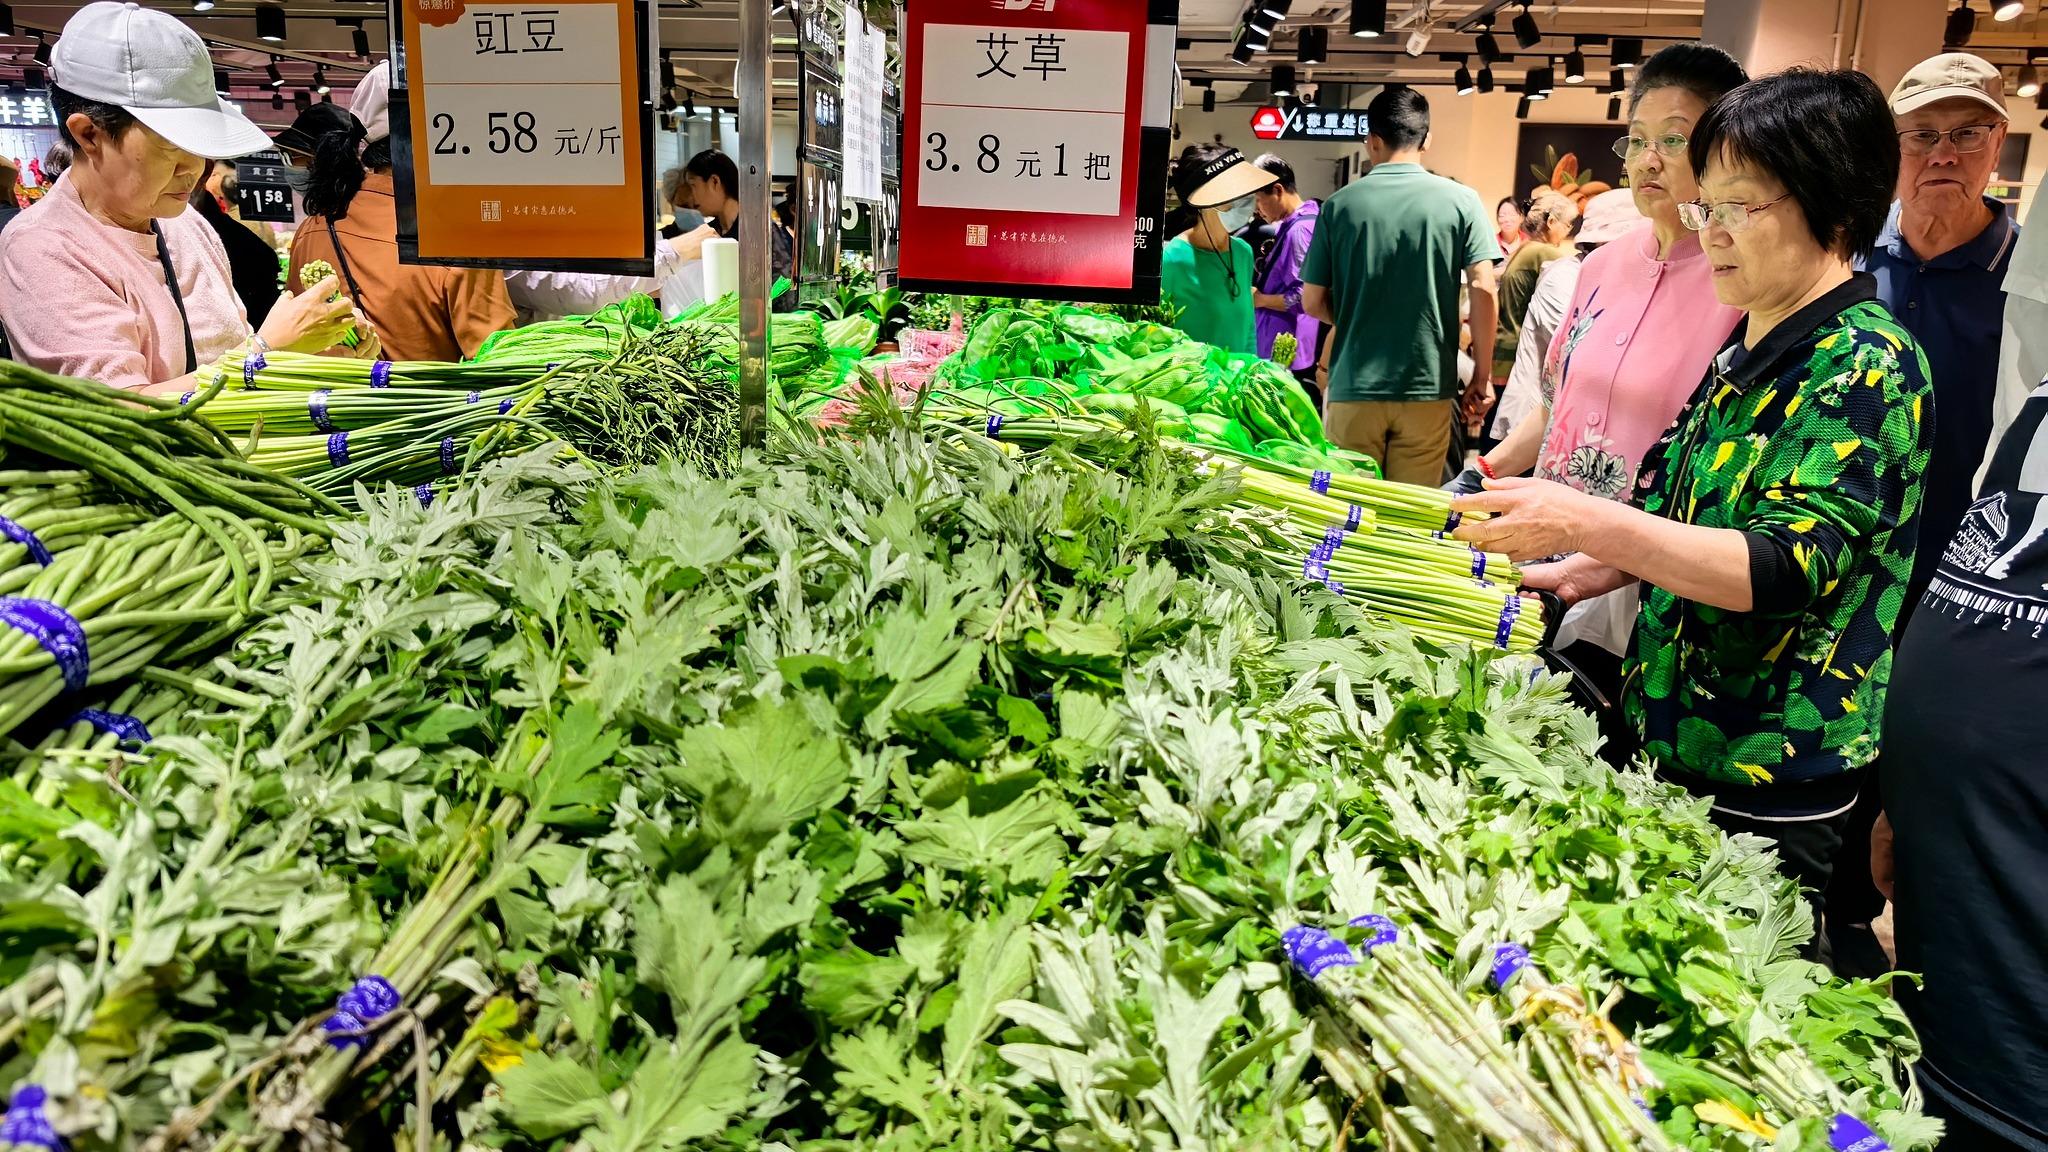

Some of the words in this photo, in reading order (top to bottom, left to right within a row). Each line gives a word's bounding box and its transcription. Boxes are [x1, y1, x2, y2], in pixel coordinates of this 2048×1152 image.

[473, 11, 564, 54] 豇豆
[976, 32, 1067, 81] 艾草
[0, 96, 58, 125] 牛羊
[432, 111, 538, 155] 2.58
[554, 126, 621, 156] 元/斤
[926, 132, 1001, 173] 3.8
[1014, 150, 1042, 178] 元
[1053, 142, 1069, 177] 1
[1084, 152, 1111, 181] 把
[1204, 161, 1224, 176] XIN
[1134, 233, 1147, 249] 克
